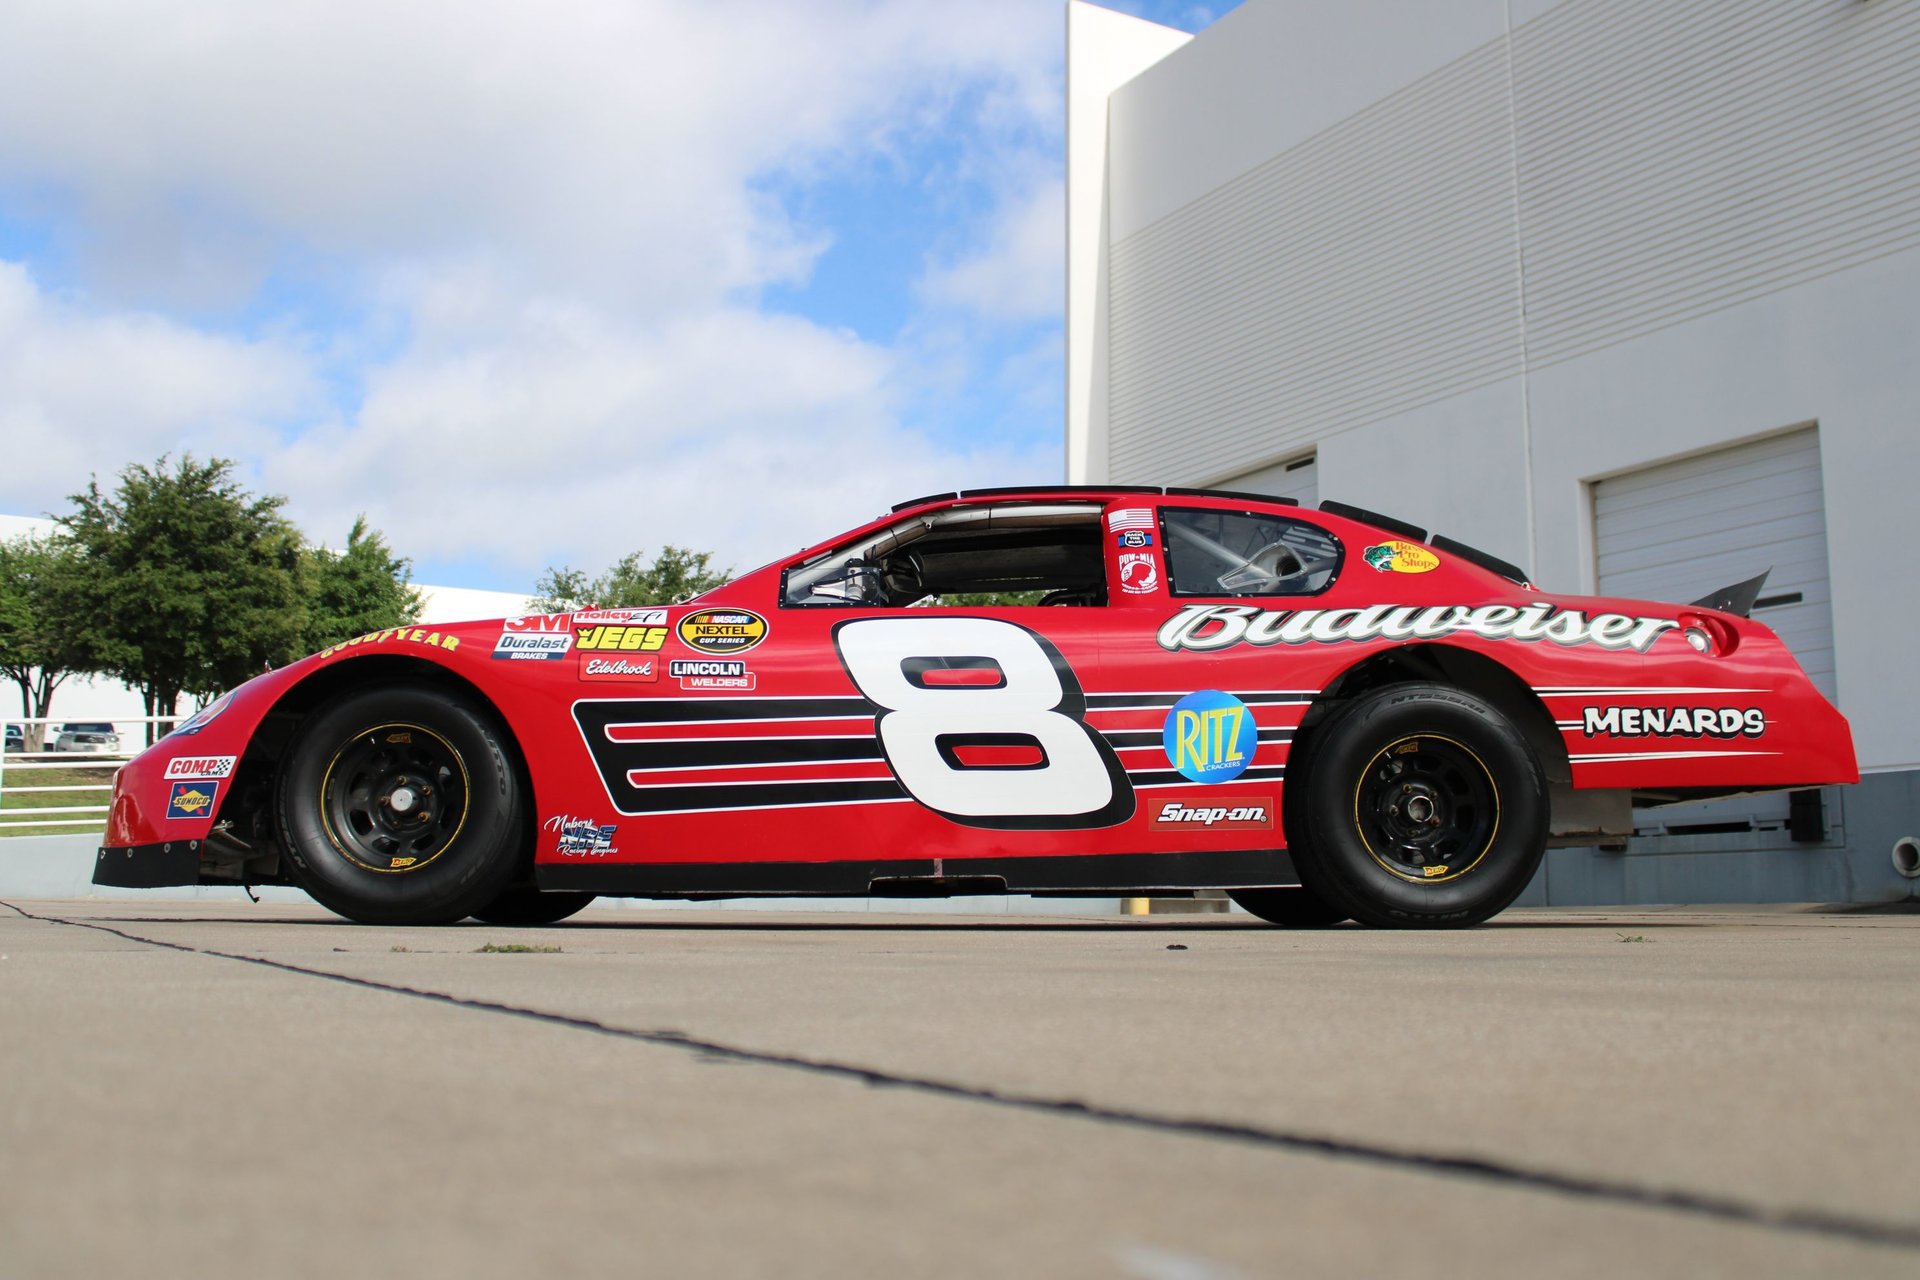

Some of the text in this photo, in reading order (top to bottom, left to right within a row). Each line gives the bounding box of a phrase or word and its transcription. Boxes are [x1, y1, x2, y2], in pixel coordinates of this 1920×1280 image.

[1395, 541, 1424, 552] Bass
[1400, 550, 1420, 559] Pro
[1401, 558, 1436, 569] Shops
[506, 613, 570, 632] 3M
[711, 615, 748, 624] NASCAR
[695, 626, 749, 635] NEXTEL
[1157, 602, 1681, 653] Budweiser
[320, 627, 460, 659] GOODYEAR
[501, 636, 568, 649] Duralast
[576, 626, 669, 651] JEGS
[510, 652, 548, 660] BRAKES
[585, 659, 652, 676] Edelbrock
[673, 663, 741, 676] LINCOLN
[690, 677, 748, 687] WELDERS
[833, 616, 1132, 827] 8
[1583, 706, 1766, 738] MENARDS
[1176, 706, 1245, 773] RITZ
[170, 759, 218, 774] COMP
[1206, 761, 1241, 771] CRACKERS
[175, 797, 208, 805] SUNOCO
[1156, 802, 1264, 825] Snap-on
[543, 814, 594, 833] Nabors
[557, 844, 618, 857] Racing Engines
